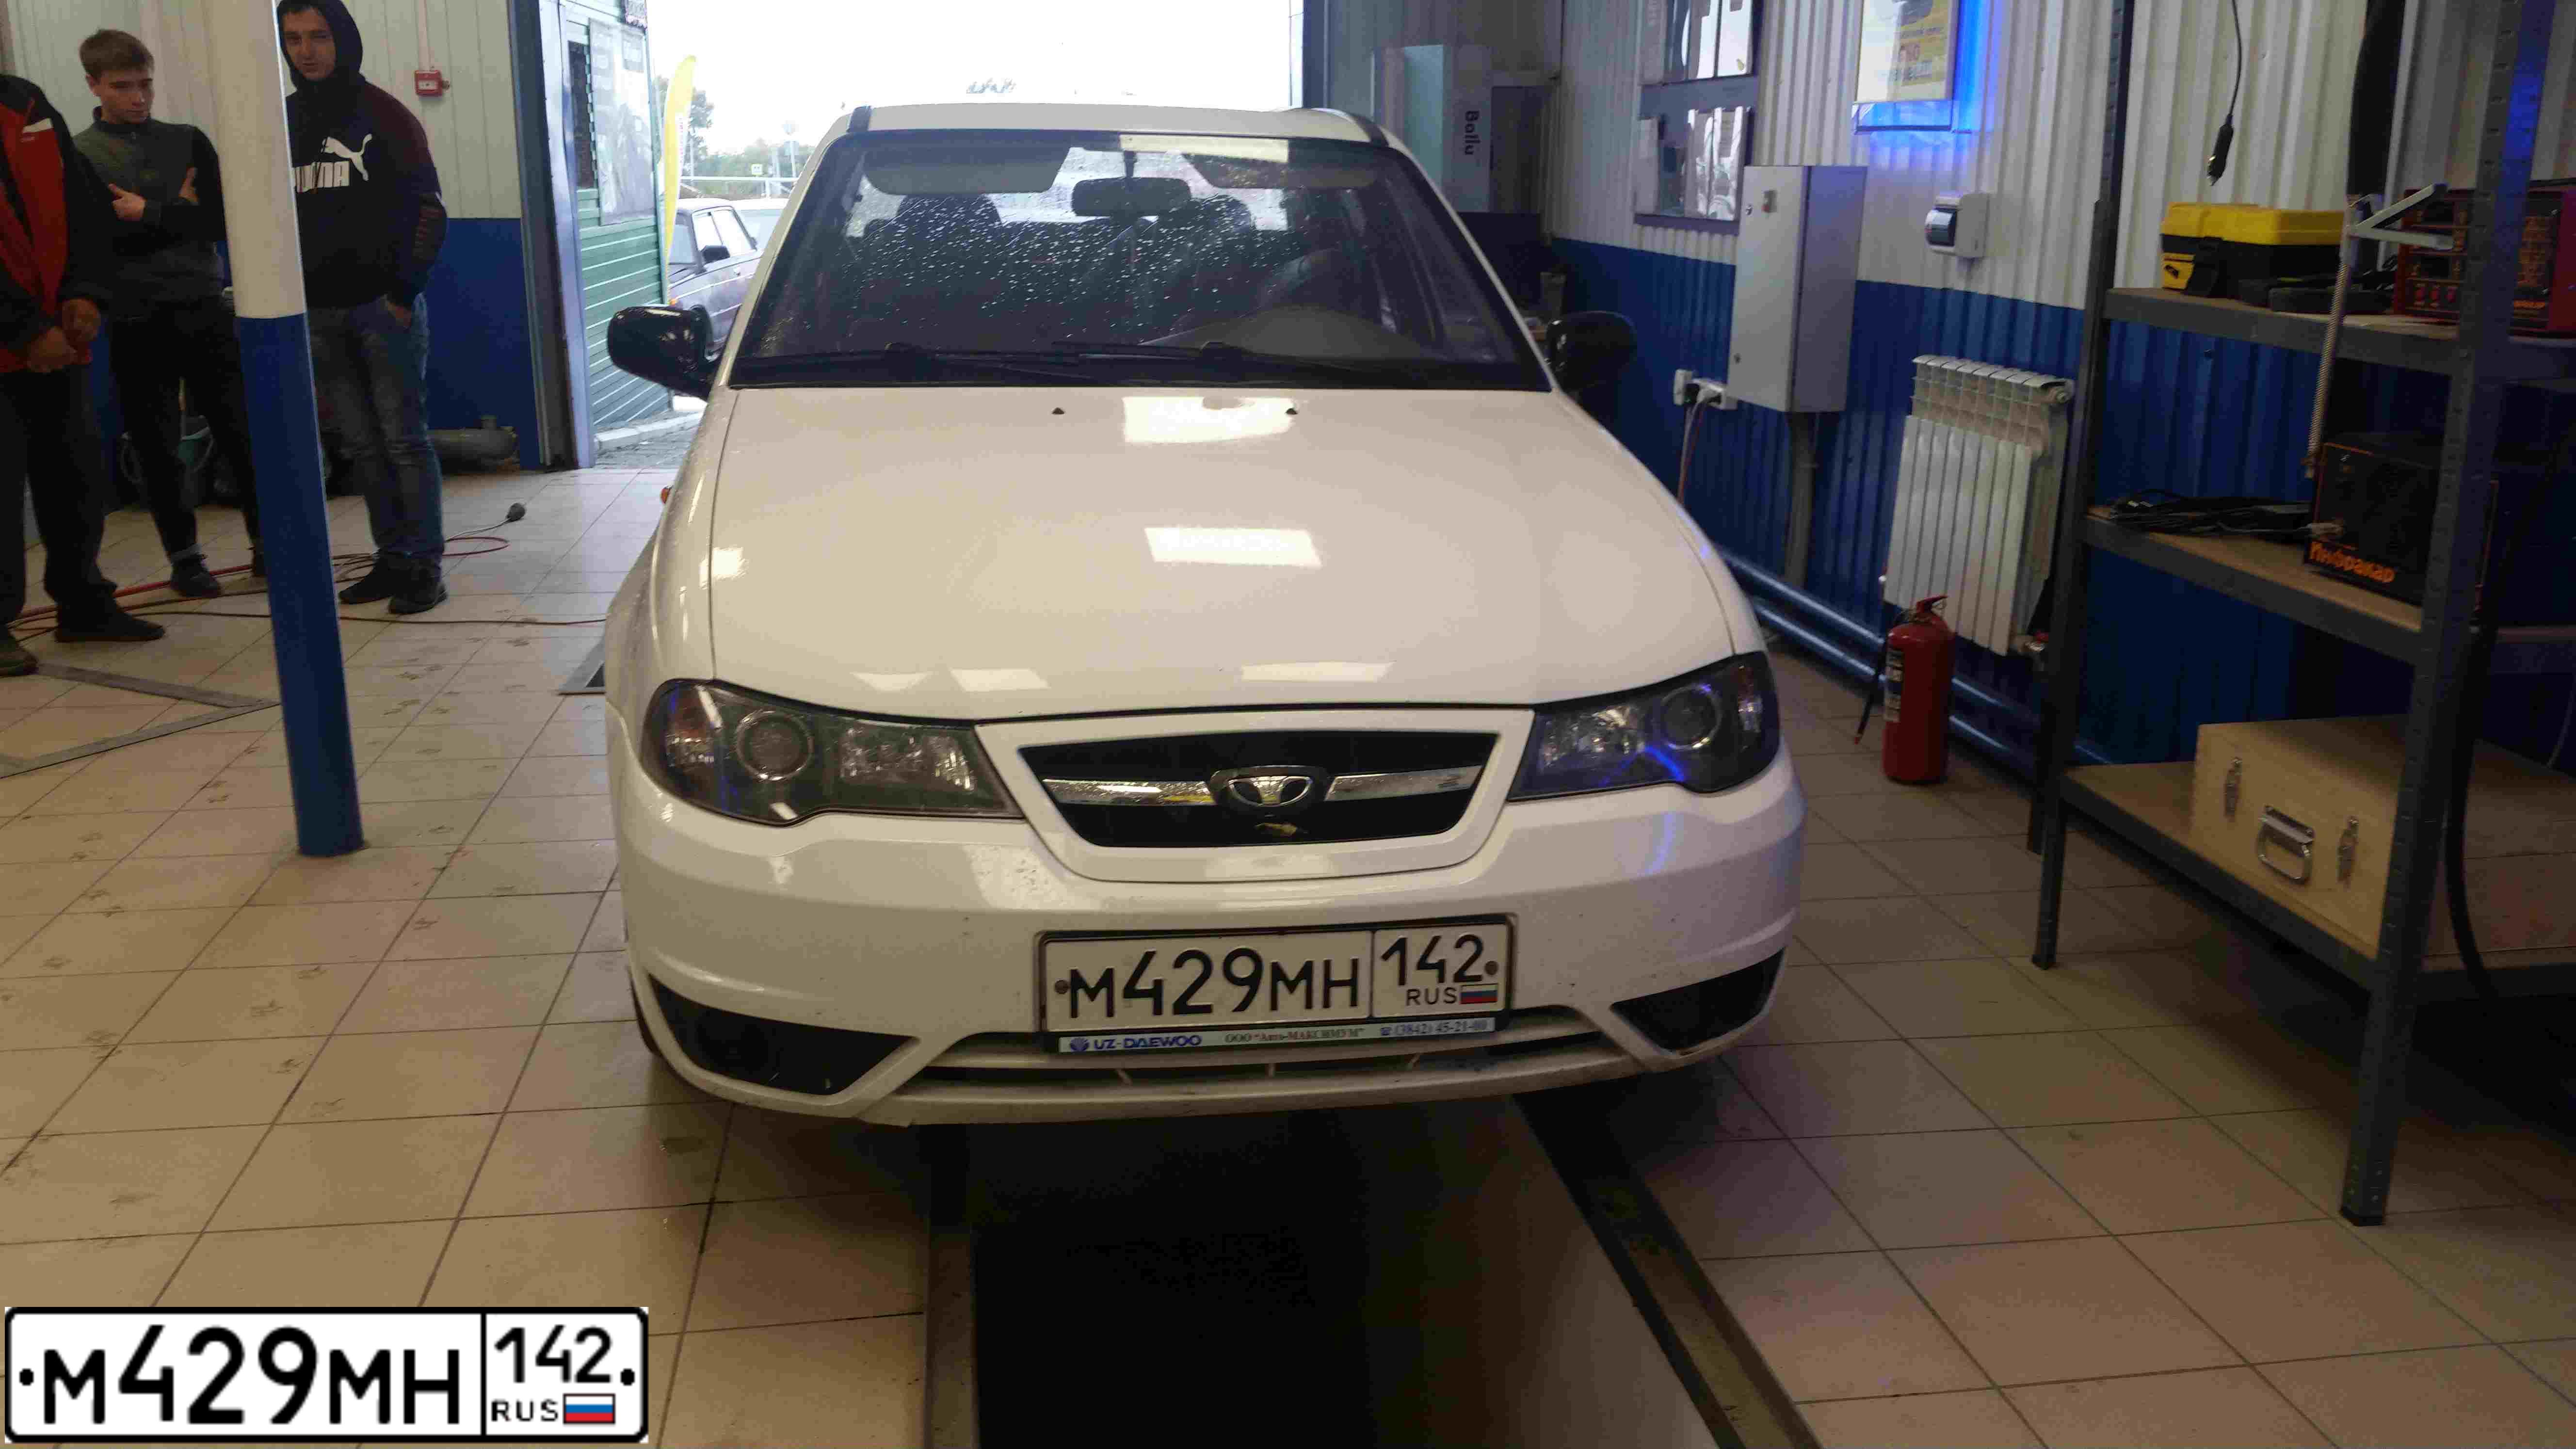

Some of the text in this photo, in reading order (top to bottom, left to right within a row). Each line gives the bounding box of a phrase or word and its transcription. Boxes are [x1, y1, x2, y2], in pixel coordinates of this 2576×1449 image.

[1465, 111, 1481, 155] Ballu
[292, 161, 350, 193] UMA
[1380, 934, 1484, 986] 142
[1406, 987, 1457, 1006] RUS
[1094, 1034, 1203, 1050] UZ-DAEWOO
